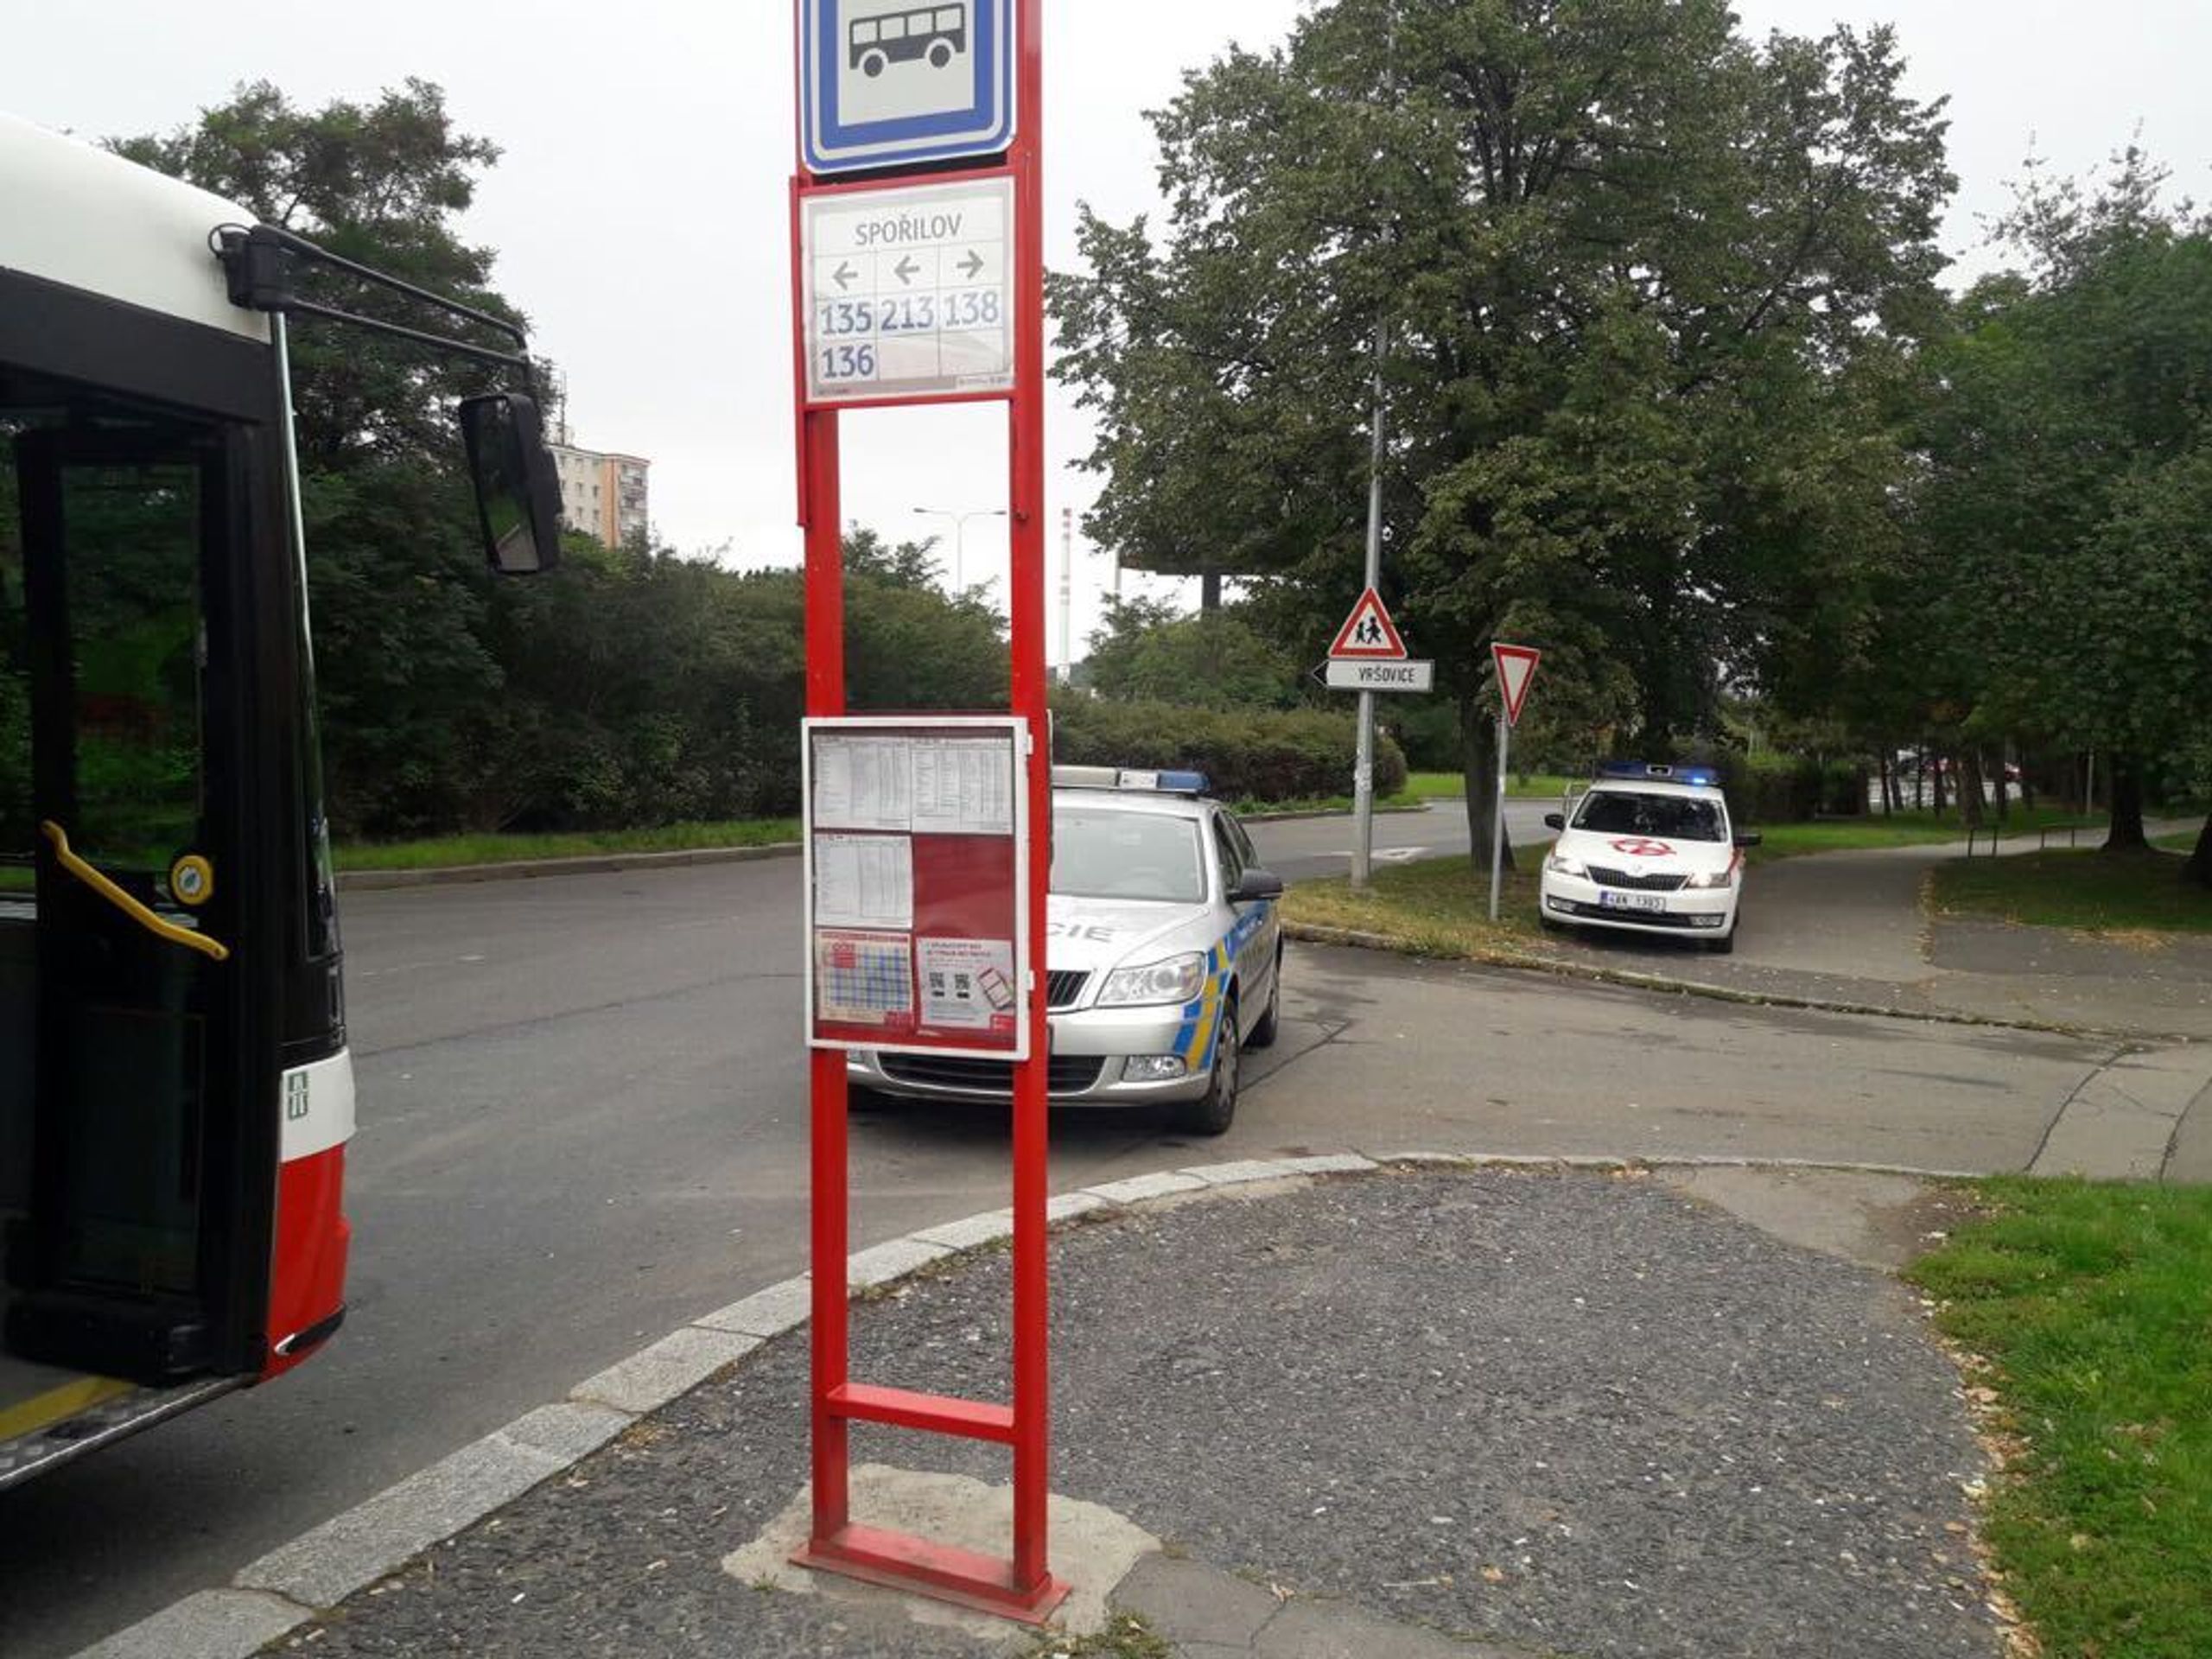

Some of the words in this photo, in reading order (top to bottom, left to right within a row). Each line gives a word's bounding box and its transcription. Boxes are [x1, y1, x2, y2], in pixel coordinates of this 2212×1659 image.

[855, 213, 963, 246] SPOŘILOV
[821, 303, 872, 334] 135
[881, 297, 933, 331] 213
[946, 291, 999, 326] 138
[822, 344, 874, 378] 136
[1359, 666, 1415, 683] VRŠOVICE
